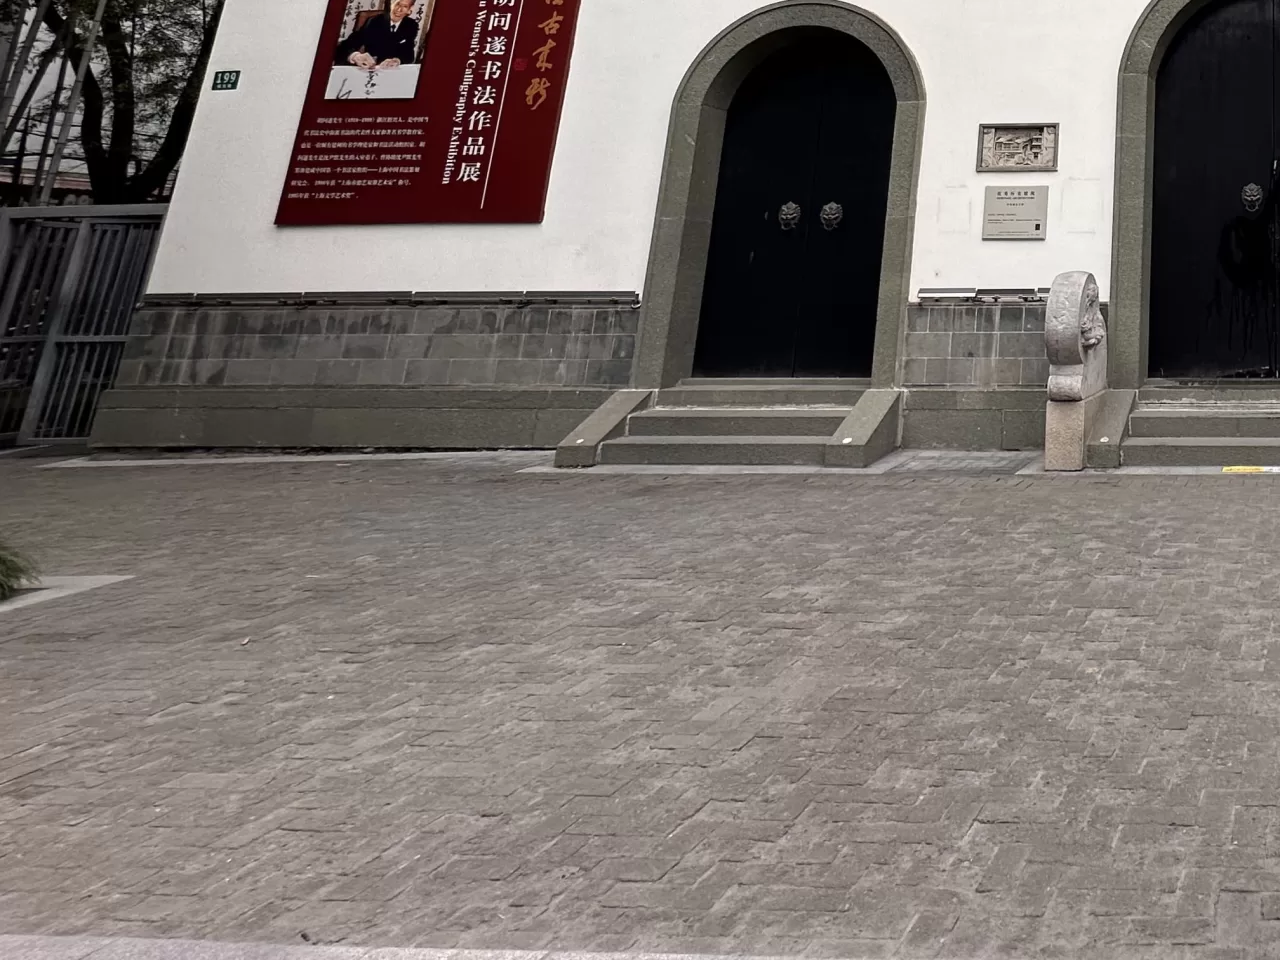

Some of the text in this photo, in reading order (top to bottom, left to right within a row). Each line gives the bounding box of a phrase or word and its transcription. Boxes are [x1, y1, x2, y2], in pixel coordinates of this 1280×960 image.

[468, 10, 487, 57] Wensui's
[216, 72, 237, 83] 199
[453, 59, 476, 123] Calligraphy
[442, 126, 462, 185] Exhibition
